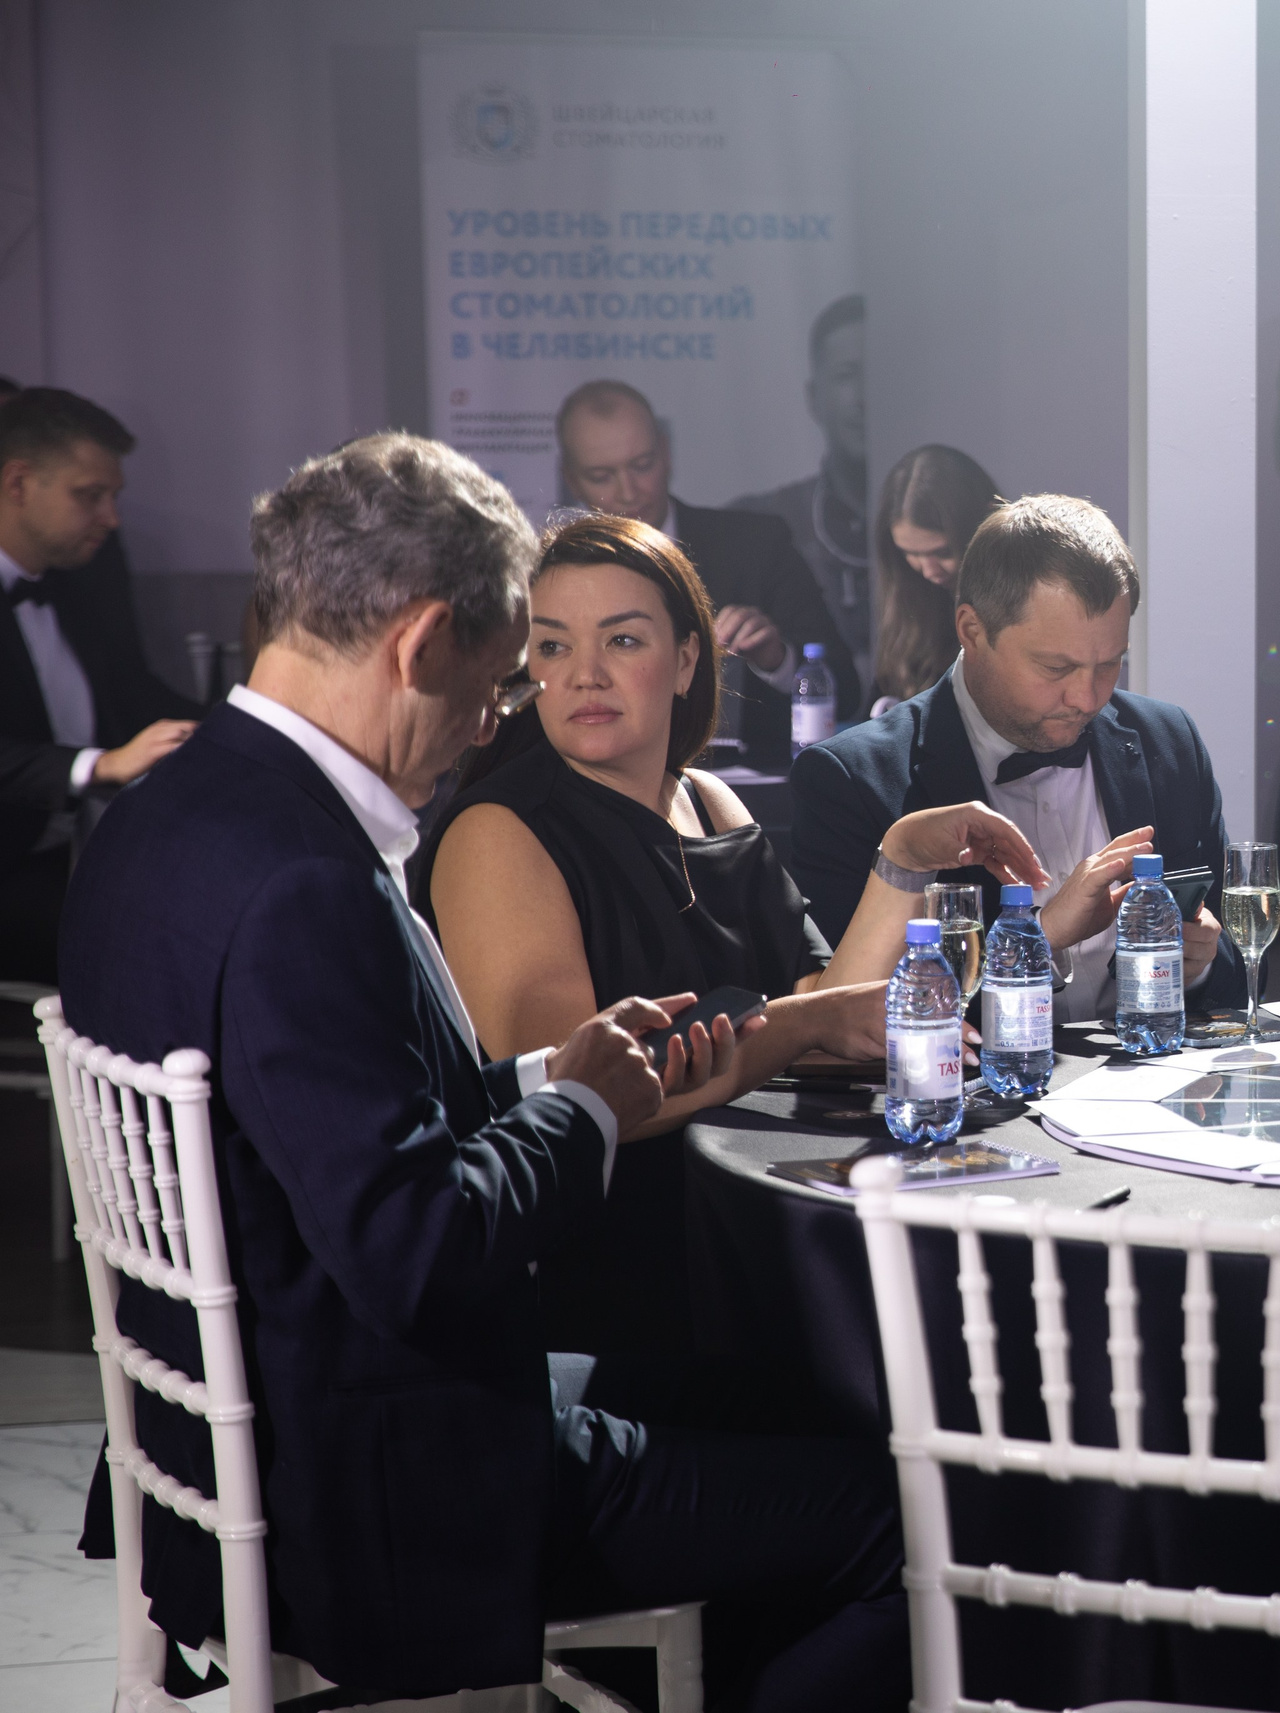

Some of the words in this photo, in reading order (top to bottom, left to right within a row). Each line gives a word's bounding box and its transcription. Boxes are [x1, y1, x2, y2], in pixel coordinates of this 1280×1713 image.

[552, 103, 716, 126] ШВЕЙЦАРСКАЯ
[552, 130, 727, 151] СТОМАТОЛОГИЯ
[447, 210, 612, 239] УРОВЕНЬ
[619, 212, 833, 246] ПЕРЕДОВЫХ
[449, 246, 714, 280] ЕВРОПЕЙСКИХ
[449, 287, 755, 320] СТОМАТОЛОГИЙ
[452, 333, 472, 360] В
[481, 332, 717, 361] ЧЕЛЯБИНСКЕ
[1036, 1004, 1051, 1014] TASS
[937, 1060, 961, 1076] TAS
